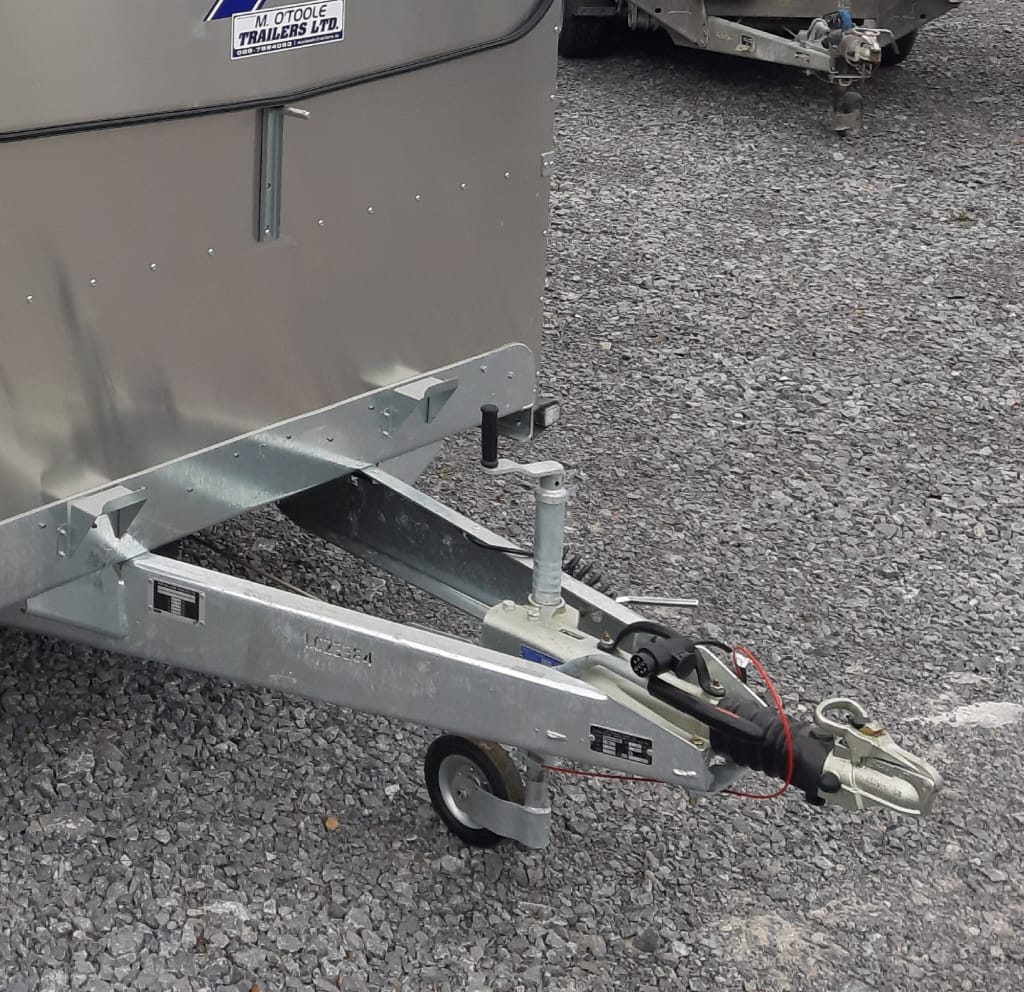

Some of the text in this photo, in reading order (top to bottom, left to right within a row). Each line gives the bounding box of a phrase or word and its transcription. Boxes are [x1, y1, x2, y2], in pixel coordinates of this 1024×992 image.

[254, 4, 328, 29] M. O'TOOLE
[238, 21, 308, 47] TRAILERS
[310, 17, 340, 35] LTD.
